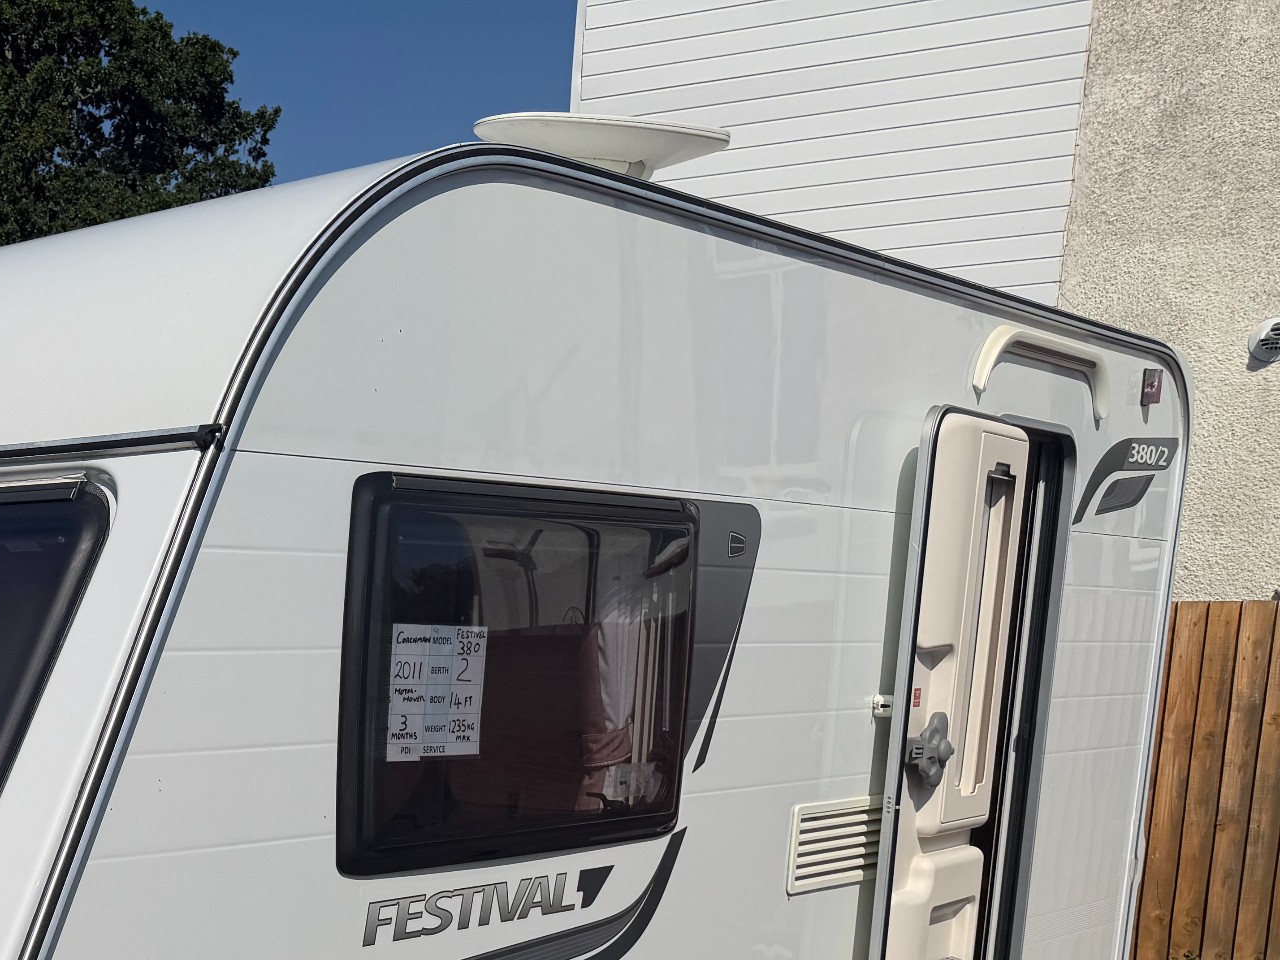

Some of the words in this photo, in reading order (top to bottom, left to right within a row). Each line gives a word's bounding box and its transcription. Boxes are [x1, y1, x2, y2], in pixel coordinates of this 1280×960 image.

[1128, 442, 1169, 466] 380/2
[432, 636, 452, 645] MODEL
[457, 640, 480, 655] 380
[394, 660, 422, 680] 2011
[431, 666, 449, 675] BERTH
[456, 657, 472, 682] 2
[429, 695, 446, 704] BODY
[399, 714, 408, 731] 3
[424, 724, 447, 733] WEIGHT
[390, 731, 418, 741] MONTHS
[455, 734, 471, 742] MAX
[400, 746, 411, 754] PDI
[422, 745, 446, 754] SERVICE
[362, 872, 576, 948] FESTIVAL
